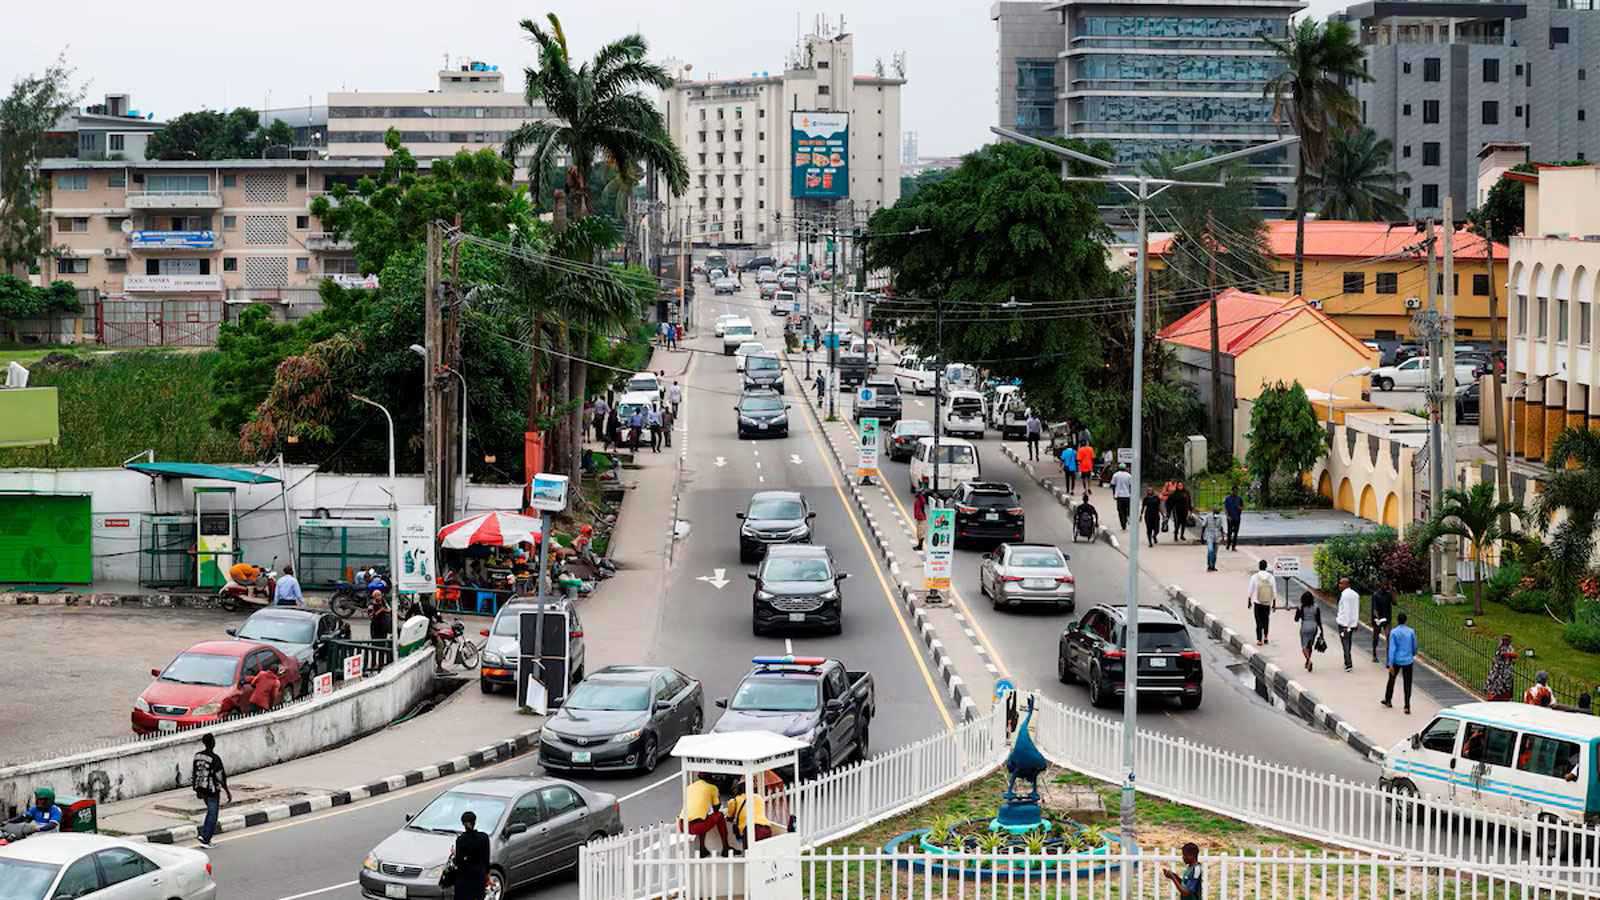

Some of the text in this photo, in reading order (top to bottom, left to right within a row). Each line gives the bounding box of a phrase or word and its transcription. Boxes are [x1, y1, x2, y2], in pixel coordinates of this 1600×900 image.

[687, 756, 743, 766] TRAFFIC OFFICER
[754, 750, 795, 764] TRAFFIC OFFICER
